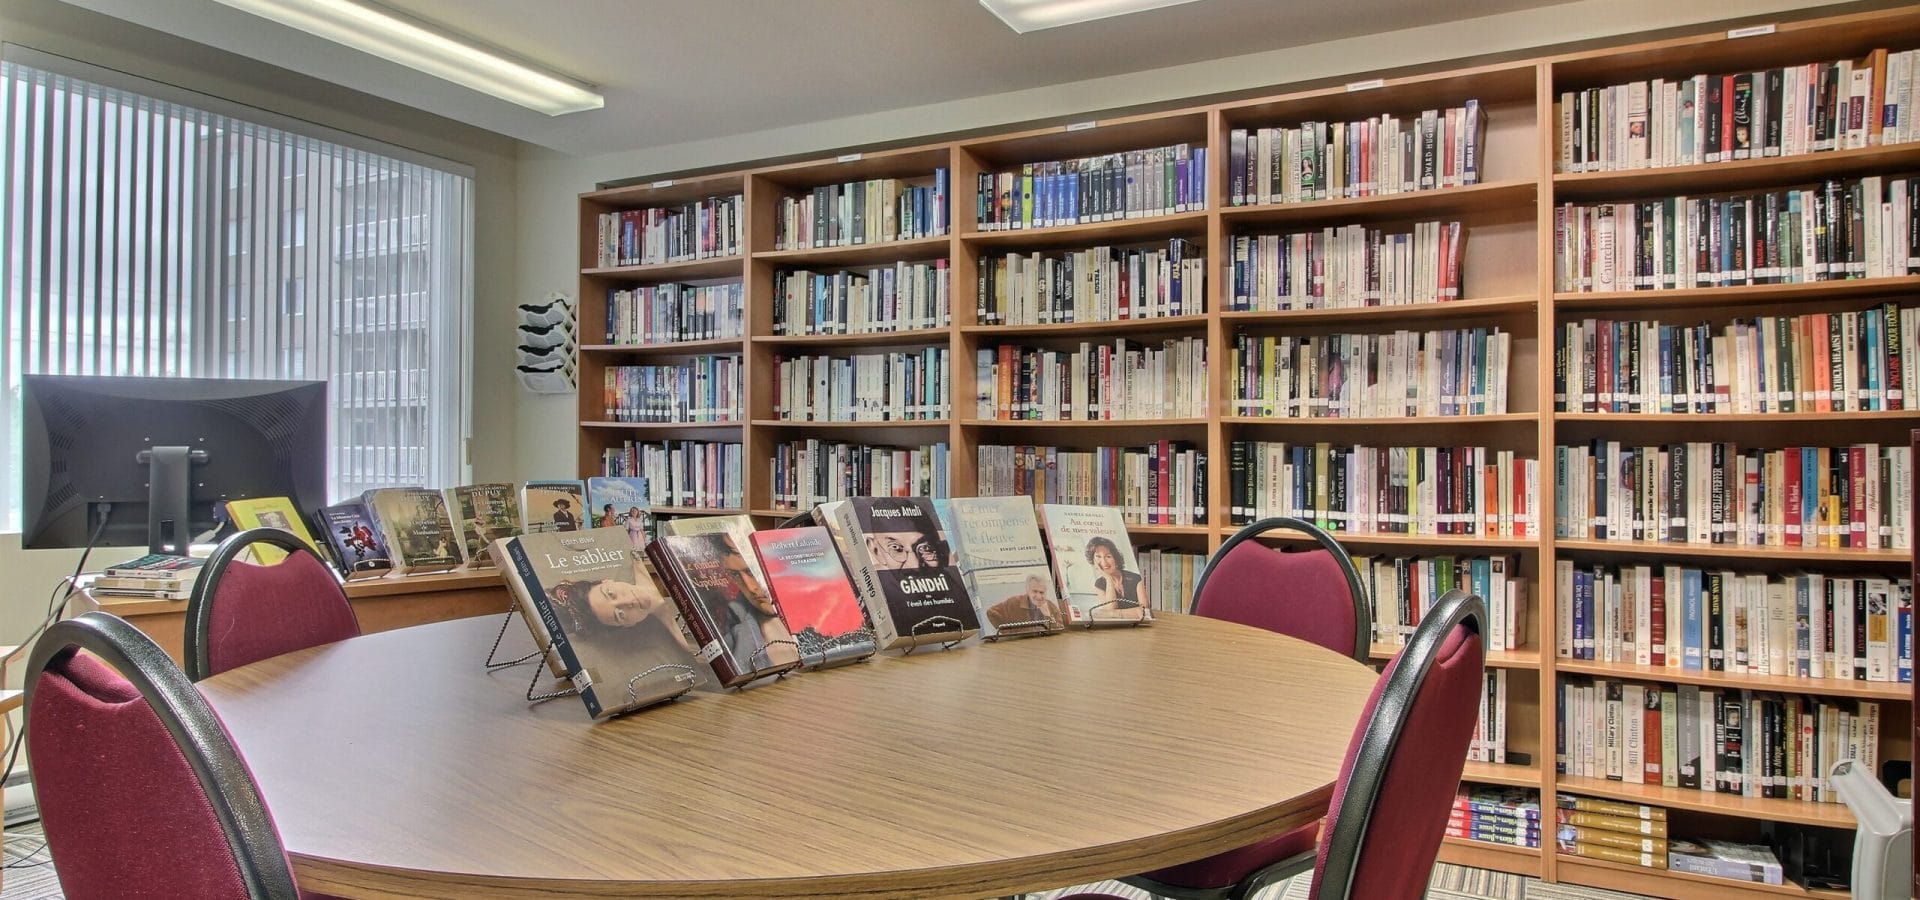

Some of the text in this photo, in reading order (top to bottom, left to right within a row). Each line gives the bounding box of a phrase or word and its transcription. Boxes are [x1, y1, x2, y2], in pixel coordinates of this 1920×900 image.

[871, 505, 922, 520] Jacques Attali
[1061, 525, 1071, 533] de
[1070, 518, 1082, 526] Au
[545, 548, 625, 569] Le sablier
[900, 573, 950, 595] GÂNDHÎ
[1627, 717, 1639, 765] Bill Clinton
